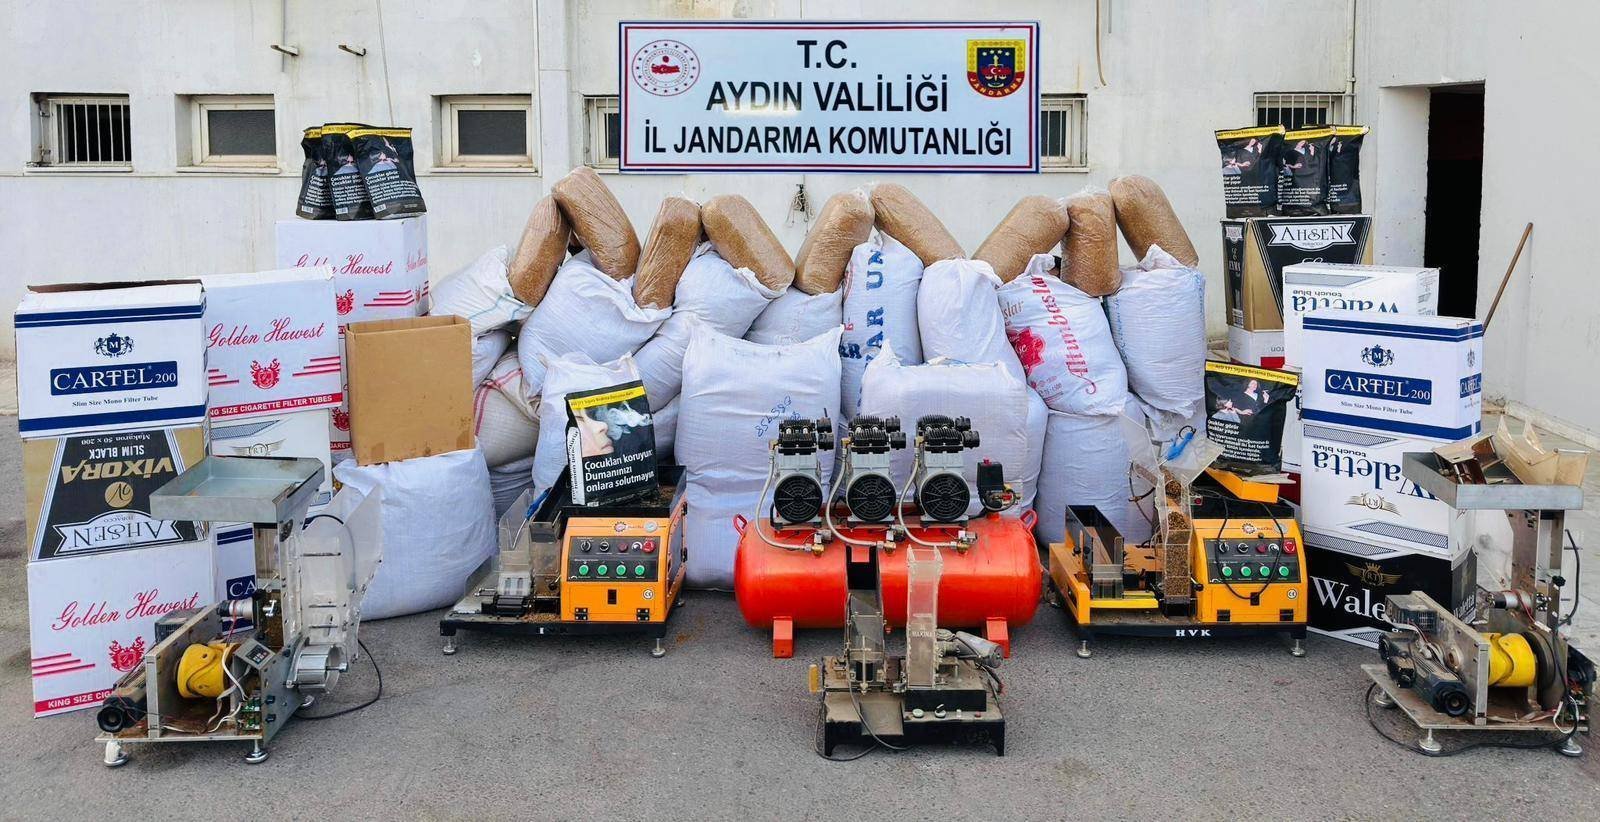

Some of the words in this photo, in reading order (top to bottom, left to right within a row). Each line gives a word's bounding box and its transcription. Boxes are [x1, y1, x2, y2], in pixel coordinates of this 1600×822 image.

[797, 39, 858, 69] T.C.
[706, 80, 801, 112] AYDIN
[813, 74, 949, 113] VALİLİĞİ
[969, 77, 1023, 96] JANDARMA
[645, 119, 667, 154] İL
[673, 126, 822, 155] JANDARMA
[829, 121, 1013, 156] KOMUTANLIĞI
[1281, 225, 1344, 241] AHSEN
[1314, 290, 1343, 298] touch
[208, 322, 260, 349] Golden
[53, 367, 154, 392] CARTEL
[155, 371, 177, 384] 200
[1327, 373, 1410, 400] CARTEL
[1411, 389, 1431, 401] 200
[221, 407, 239, 416] SIZE
[239, 402, 281, 413] CIGARETTE
[282, 398, 308, 408] FILTER
[308, 394, 333, 404] TUBES
[81, 438, 94, 446] 200
[104, 435, 115, 443] 50
[89, 446, 118, 460] BLACK
[121, 444, 145, 457] SLIM
[1312, 443, 1335, 453] blue
[1336, 448, 1367, 458] touch
[585, 465, 633, 482] Dumanınızı
[586, 481, 614, 493] onlara
[74, 520, 164, 548] AHSEN
[51, 600, 121, 631] Golden
[48, 696, 71, 709] KING
[73, 693, 94, 705] SIZE
